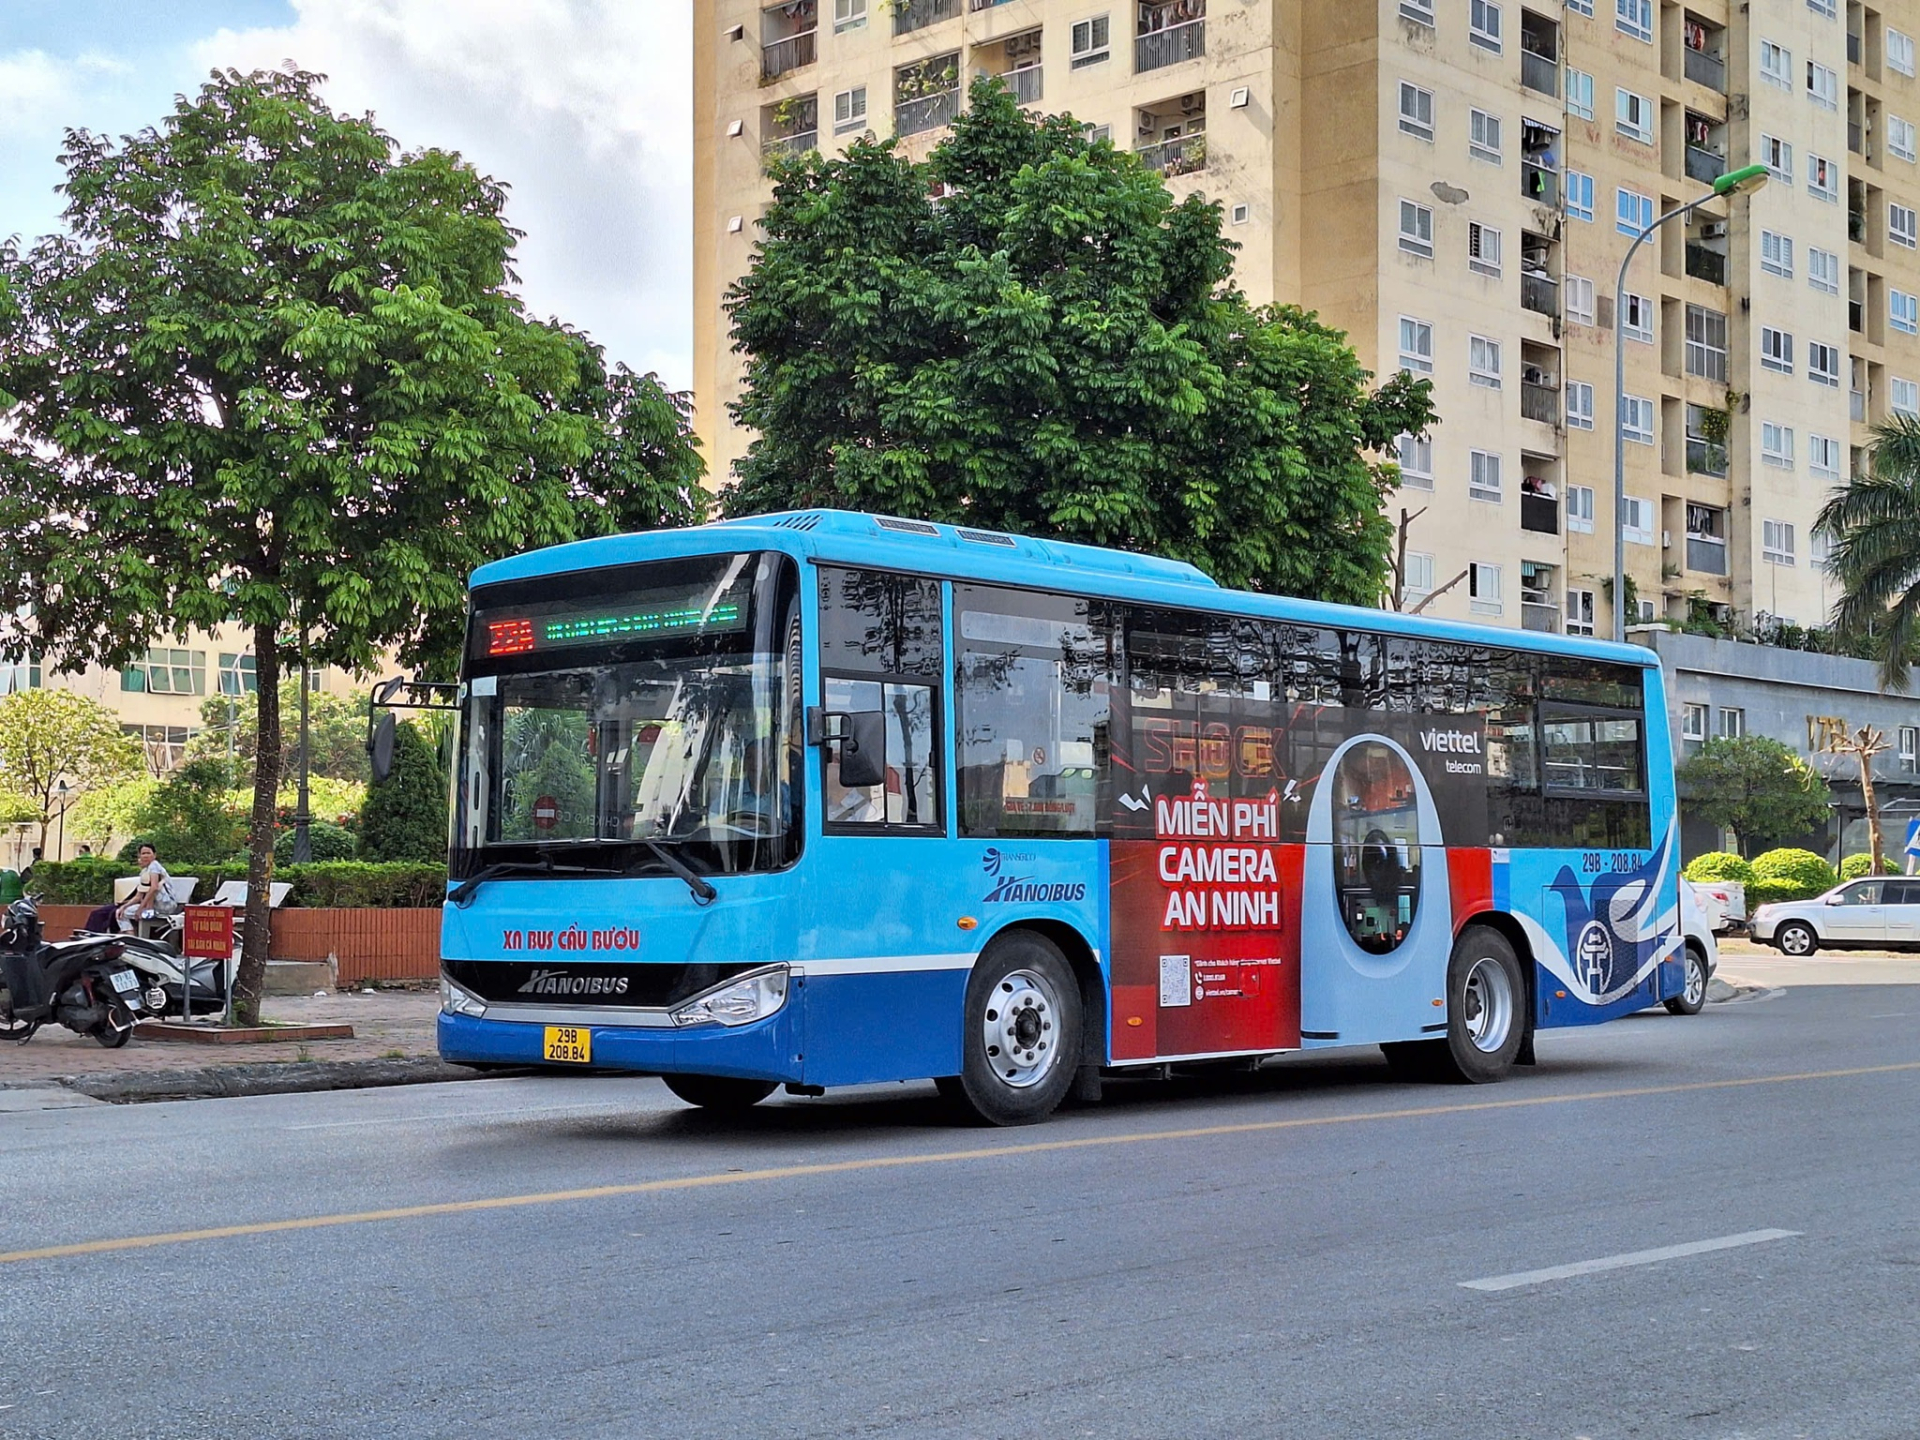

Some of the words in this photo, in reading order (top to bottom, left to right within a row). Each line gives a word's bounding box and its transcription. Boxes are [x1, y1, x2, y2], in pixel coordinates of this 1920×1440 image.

[1144, 717, 1287, 780] SHOCK
[1419, 728, 1482, 755] viettel
[1445, 759, 1482, 775] telecom
[1157, 782, 1229, 837] MIỄN
[1234, 792, 1278, 838] PHÍ
[1159, 846, 1278, 884] CAMERA
[1582, 853, 1601, 873] 29B
[1610, 853, 1643, 873] 208.84
[982, 875, 1086, 903] HANOIBUS
[1163, 891, 1207, 927] AN
[1212, 891, 1279, 927] NINH
[527, 930, 554, 950] BUS
[557, 922, 588, 950] CẦU
[592, 926, 639, 951] BƯƠU
[517, 969, 629, 994] HANOIBUS
[557, 1028, 577, 1044] 29B
[549, 1044, 585, 1061] 208.84
